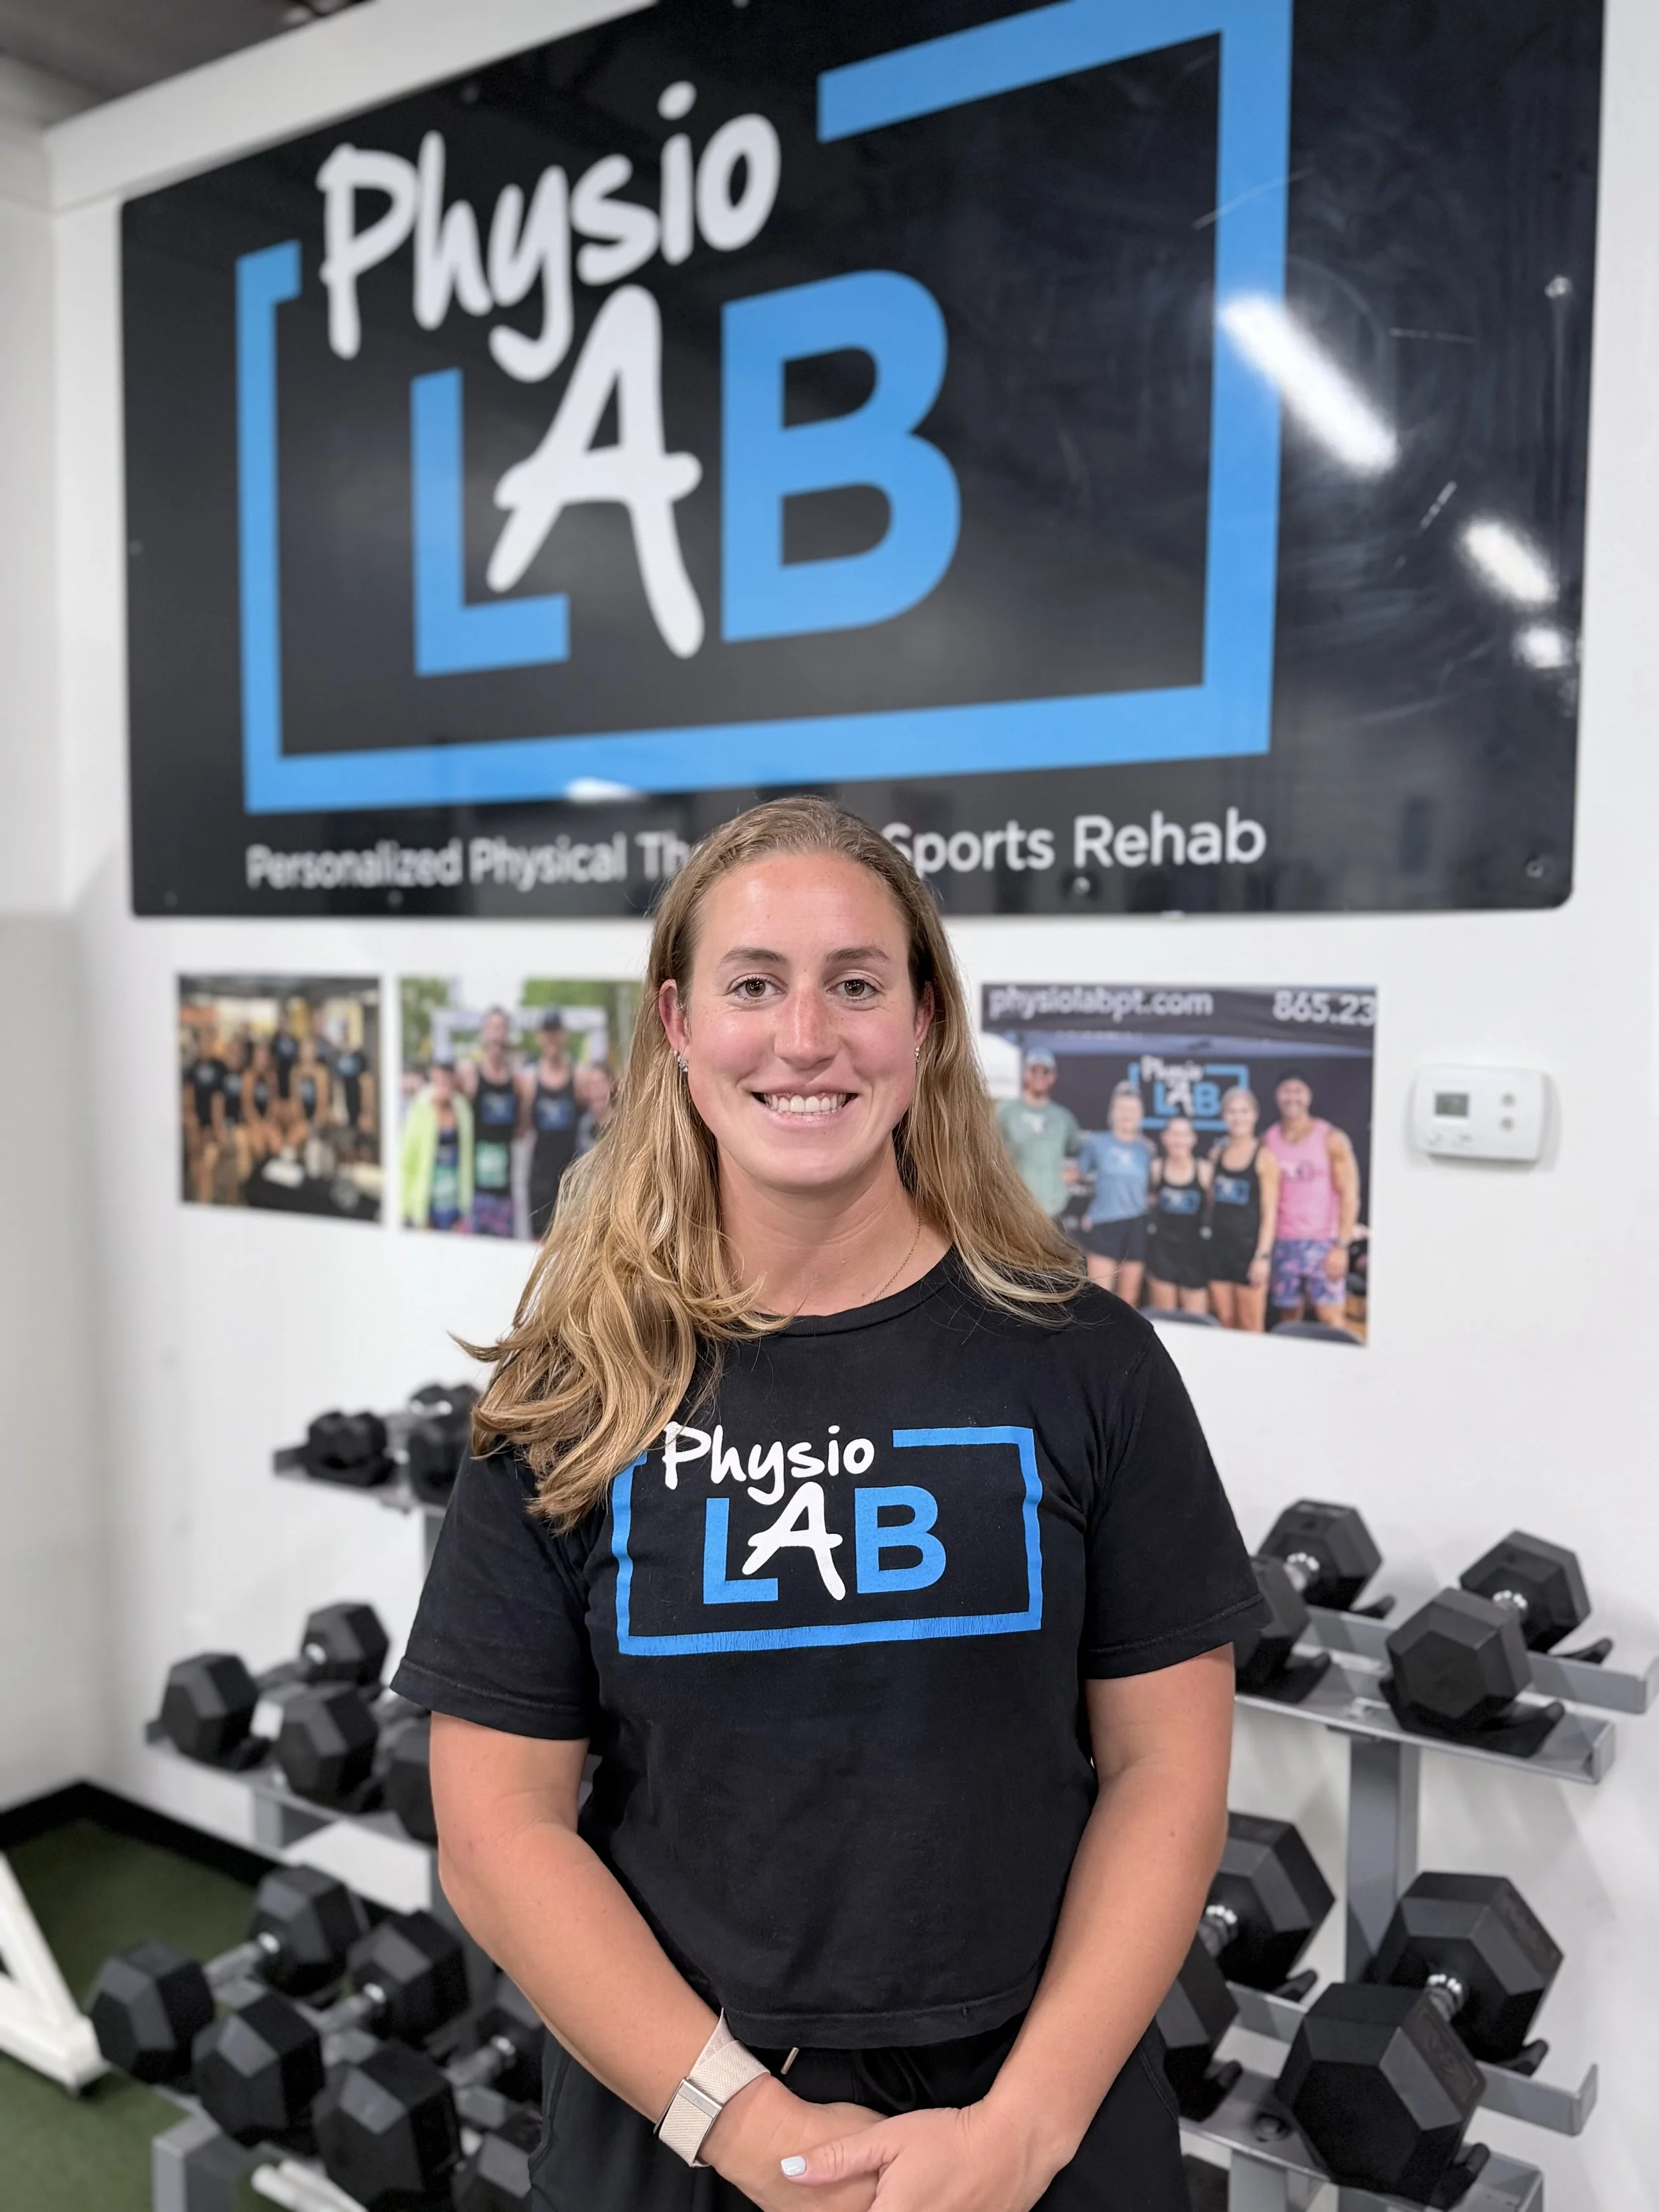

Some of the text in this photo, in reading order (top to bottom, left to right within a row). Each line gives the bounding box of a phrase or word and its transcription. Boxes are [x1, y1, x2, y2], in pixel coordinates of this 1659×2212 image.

[316, 80, 781, 383] Physio
[411, 269, 962, 678] LAB
[246, 837, 463, 889] Personalized
[469, 832, 627, 892] Physical
[882, 820, 1055, 879] Sports
[1074, 806, 1267, 868] Rehab
[989, 985, 1214, 1023] physiolabpt.com
[1271, 989, 1376, 1027] 865.23
[1153, 1080, 1221, 1118] LAB
[662, 1421, 875, 1506] Physio
[703, 1481, 947, 1605] LAB
